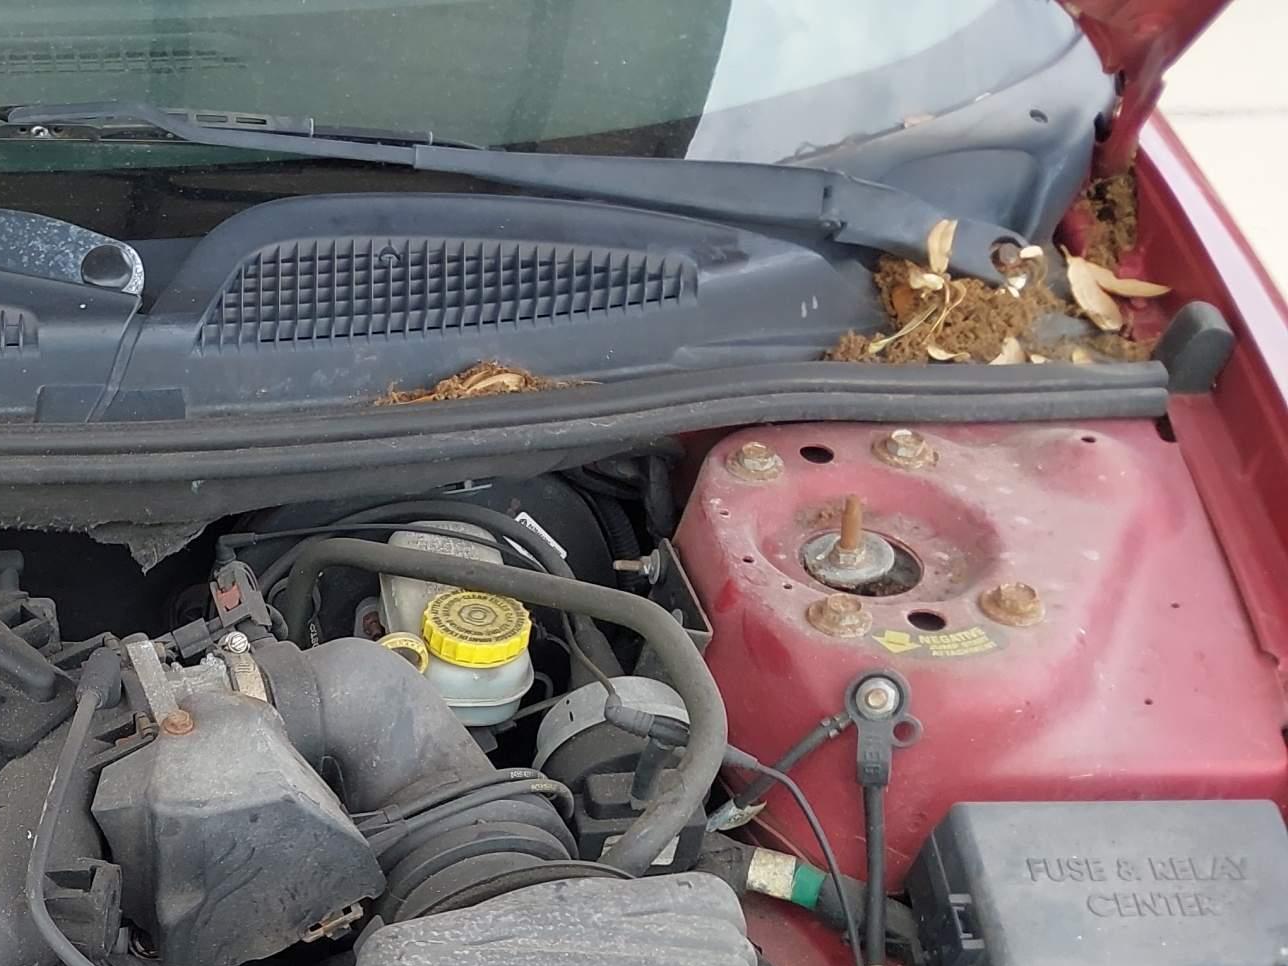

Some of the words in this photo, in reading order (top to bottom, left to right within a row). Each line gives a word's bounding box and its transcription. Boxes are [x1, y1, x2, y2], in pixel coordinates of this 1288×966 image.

[918, 626, 985, 644] NEGATIVE
[1026, 857, 1107, 882] FUSE
[1116, 858, 1142, 881] &
[1148, 857, 1248, 881] RELAY
[1086, 892, 1221, 917] CENTER
